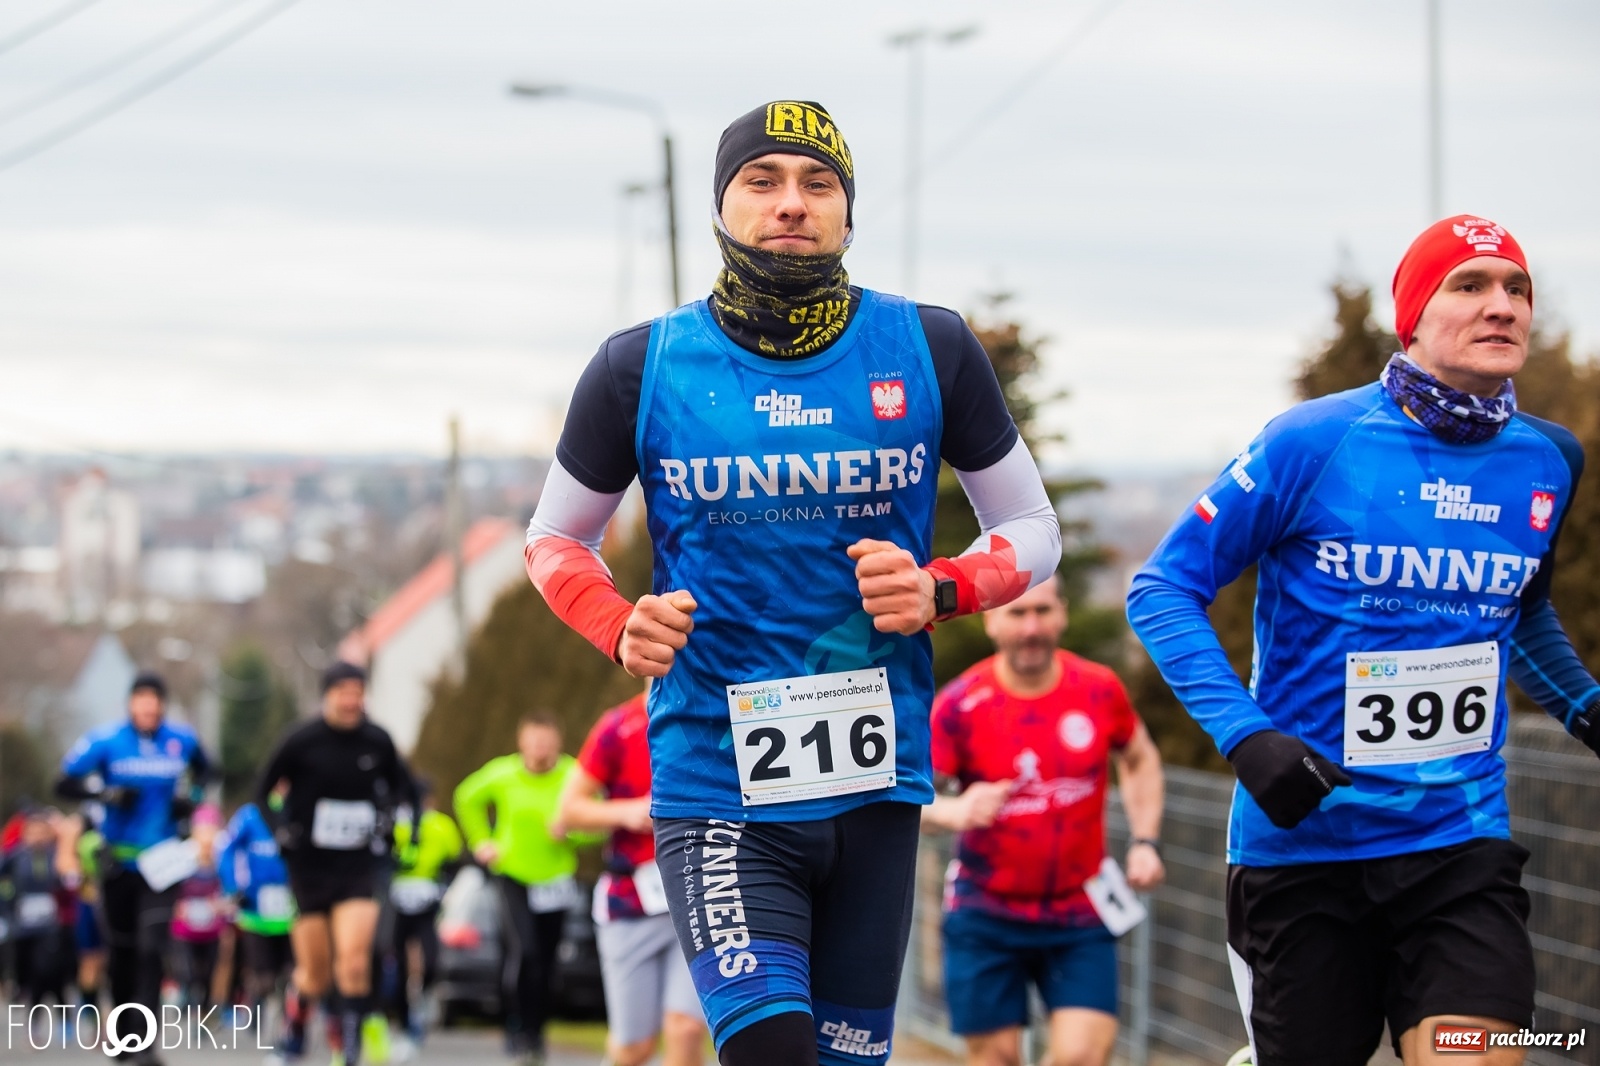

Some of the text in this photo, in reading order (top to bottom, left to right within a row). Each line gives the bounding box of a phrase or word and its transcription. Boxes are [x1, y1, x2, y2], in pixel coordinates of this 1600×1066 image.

[868, 370, 903, 380] POLAND
[754, 389, 802, 412] eko
[769, 408, 832, 427] okna
[659, 443, 926, 501] RUNNERS
[1420, 477, 1472, 503] eko
[834, 502, 892, 519] TEAM
[1435, 500, 1501, 524] okna
[1356, 655, 1493, 672] PersonalBest www.personalbest.pl
[736, 682, 884, 702] PersonalBest www.personalbest.pl
[1356, 685, 1488, 743] 396
[745, 714, 887, 782] 216
[688, 908, 705, 952] TEAM
